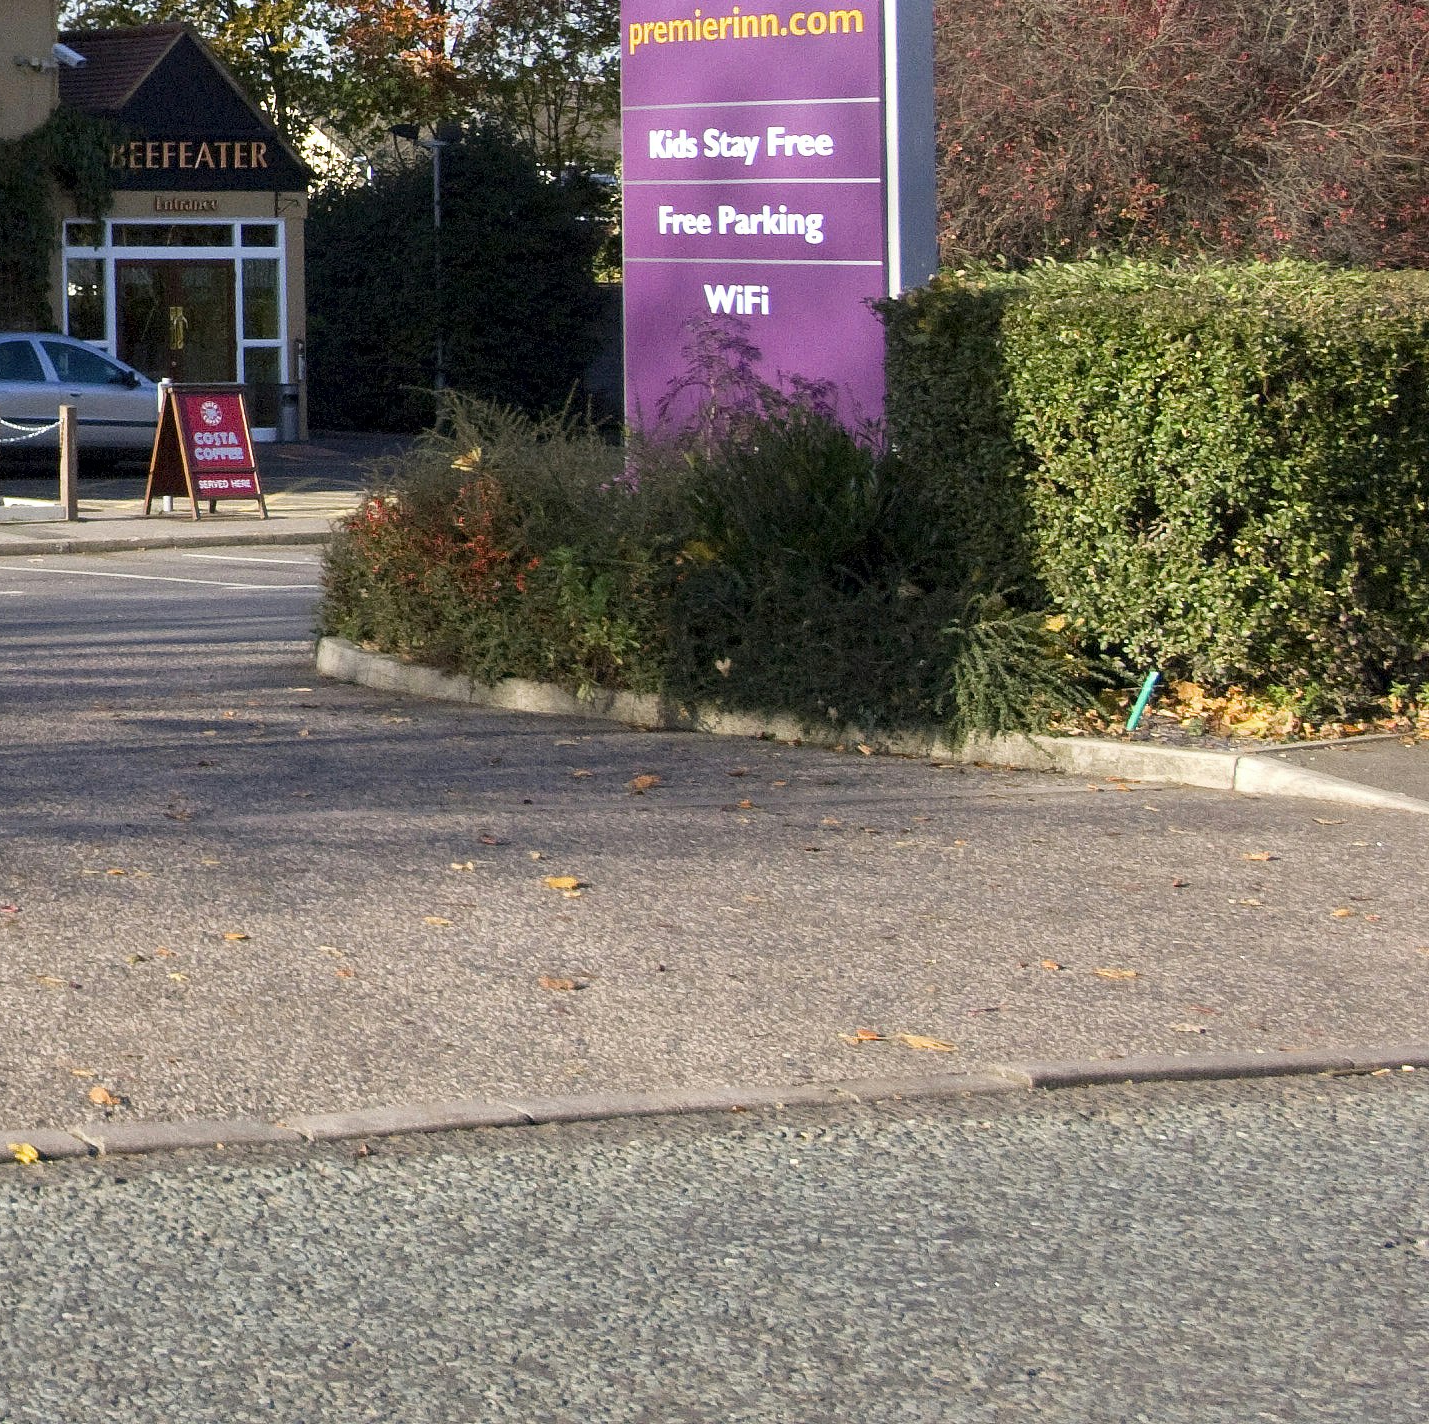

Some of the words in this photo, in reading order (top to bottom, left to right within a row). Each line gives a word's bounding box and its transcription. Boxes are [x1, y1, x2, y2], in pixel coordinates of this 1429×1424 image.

[628, 5, 865, 56] premierinn.com
[648, 129, 699, 160] Kids
[702, 127, 761, 166] Stay
[766, 125, 834, 157] Free
[154, 195, 219, 212] Entrance
[657, 205, 712, 236] Free
[717, 204, 825, 245] Parking
[703, 283, 772, 316] WiFi
[194, 431, 239, 446] COSTA
[194, 447, 245, 461] COFFEE
[198, 479, 229, 489] SERVED
[230, 479, 252, 488] HERE
